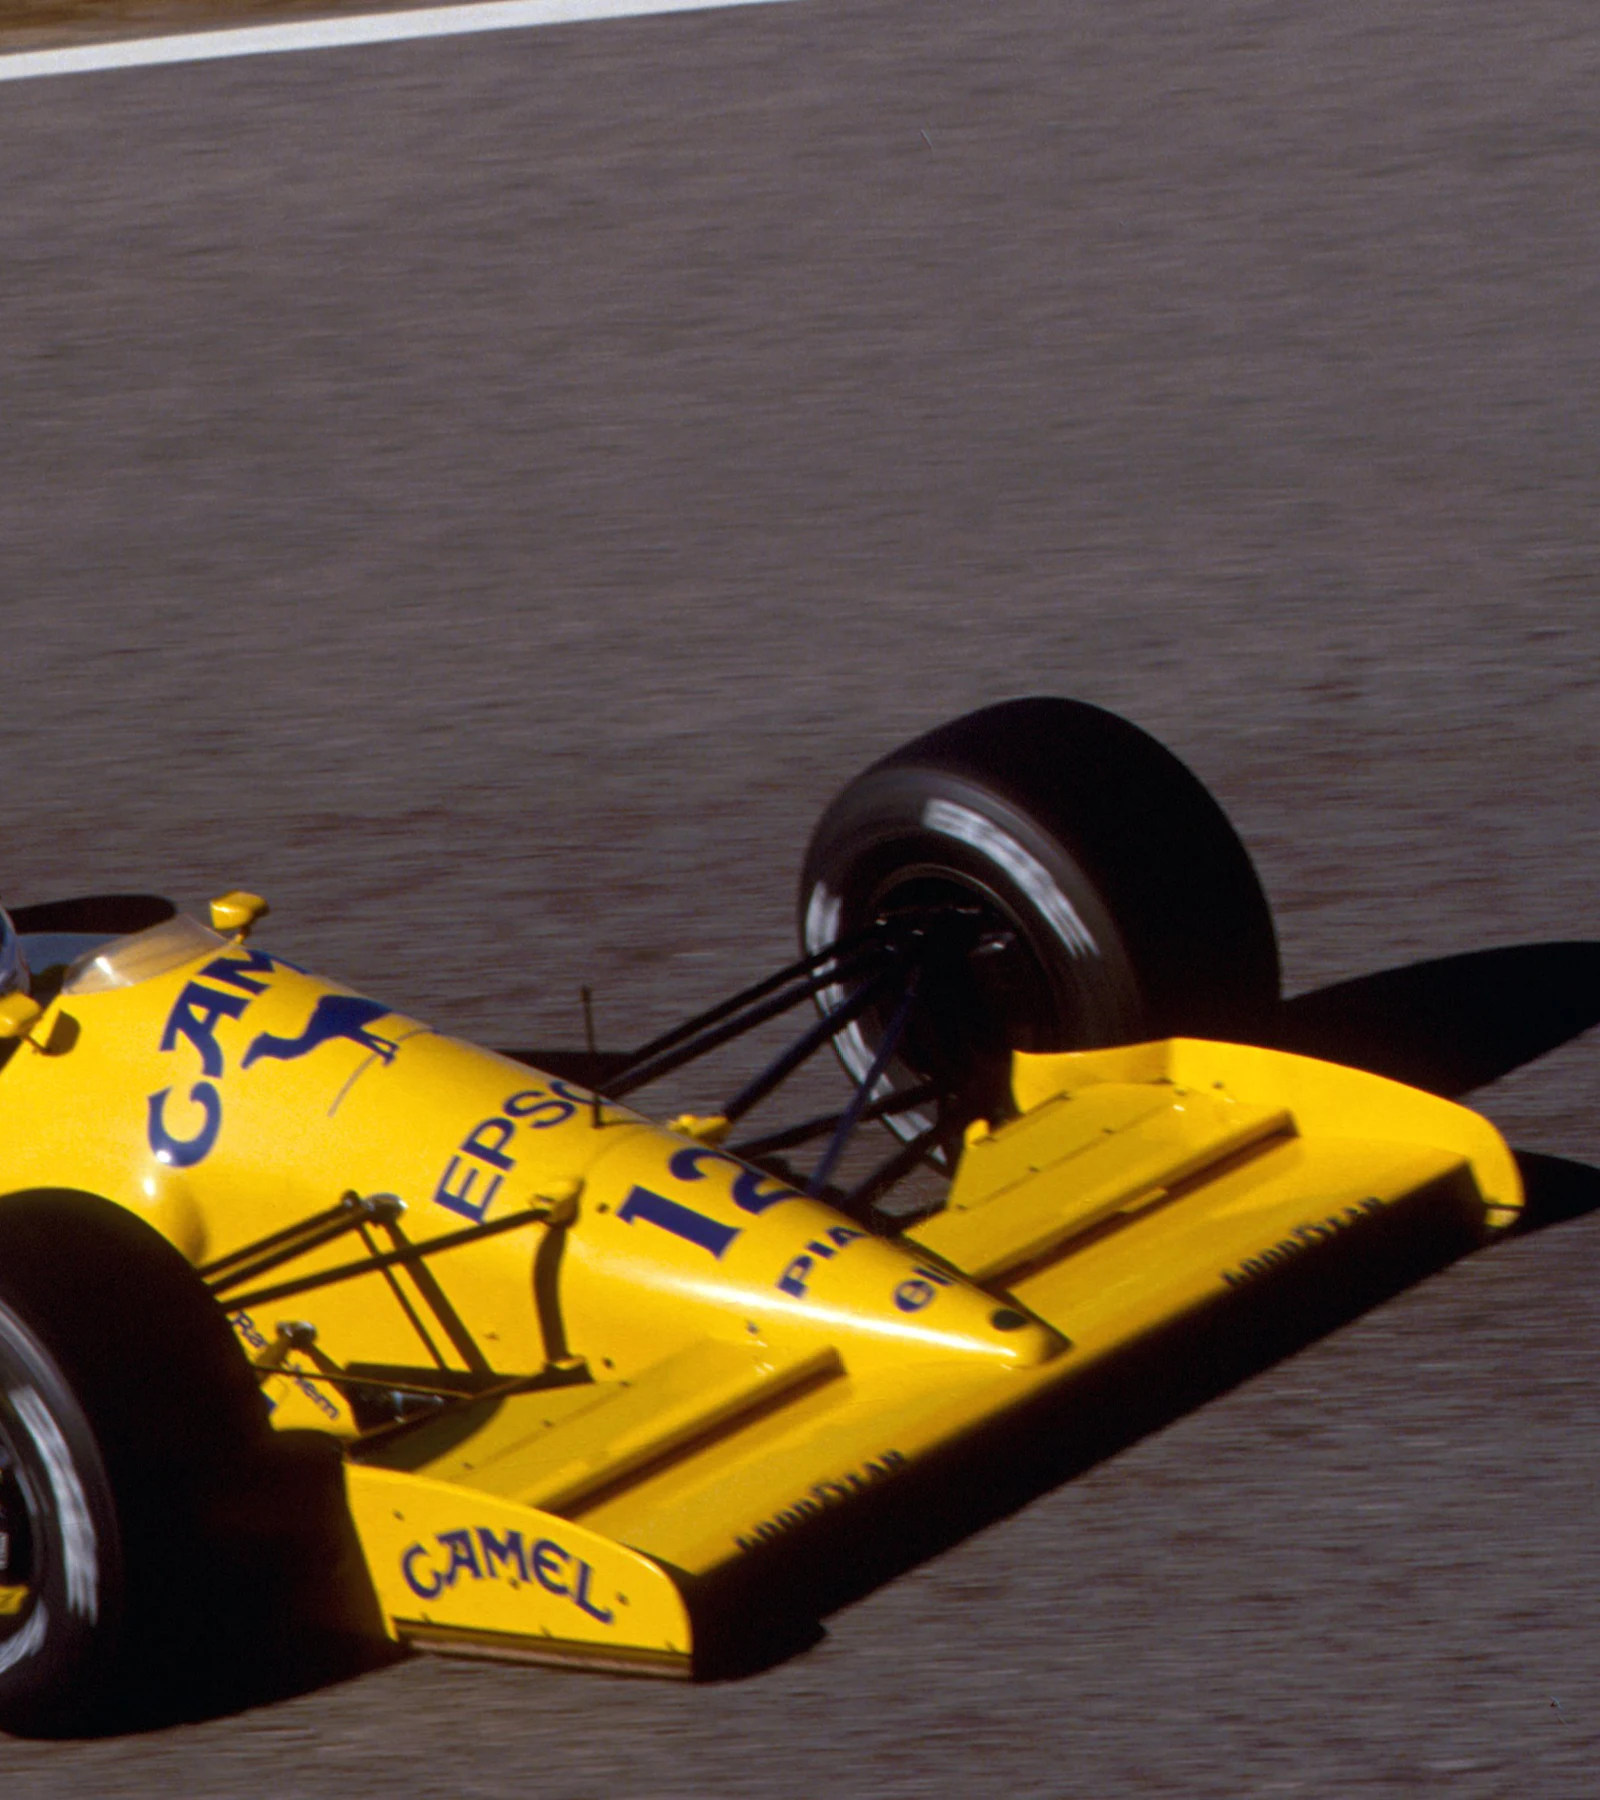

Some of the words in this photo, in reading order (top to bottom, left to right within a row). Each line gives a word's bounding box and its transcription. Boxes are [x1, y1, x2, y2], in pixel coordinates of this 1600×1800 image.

[147, 949, 312, 1168] CAM
[616, 1147, 805, 1261] 12
[776, 1226, 868, 1299] PIA
[232, 1308, 340, 1421] Rahem
[402, 1527, 613, 1624] CAMEL
